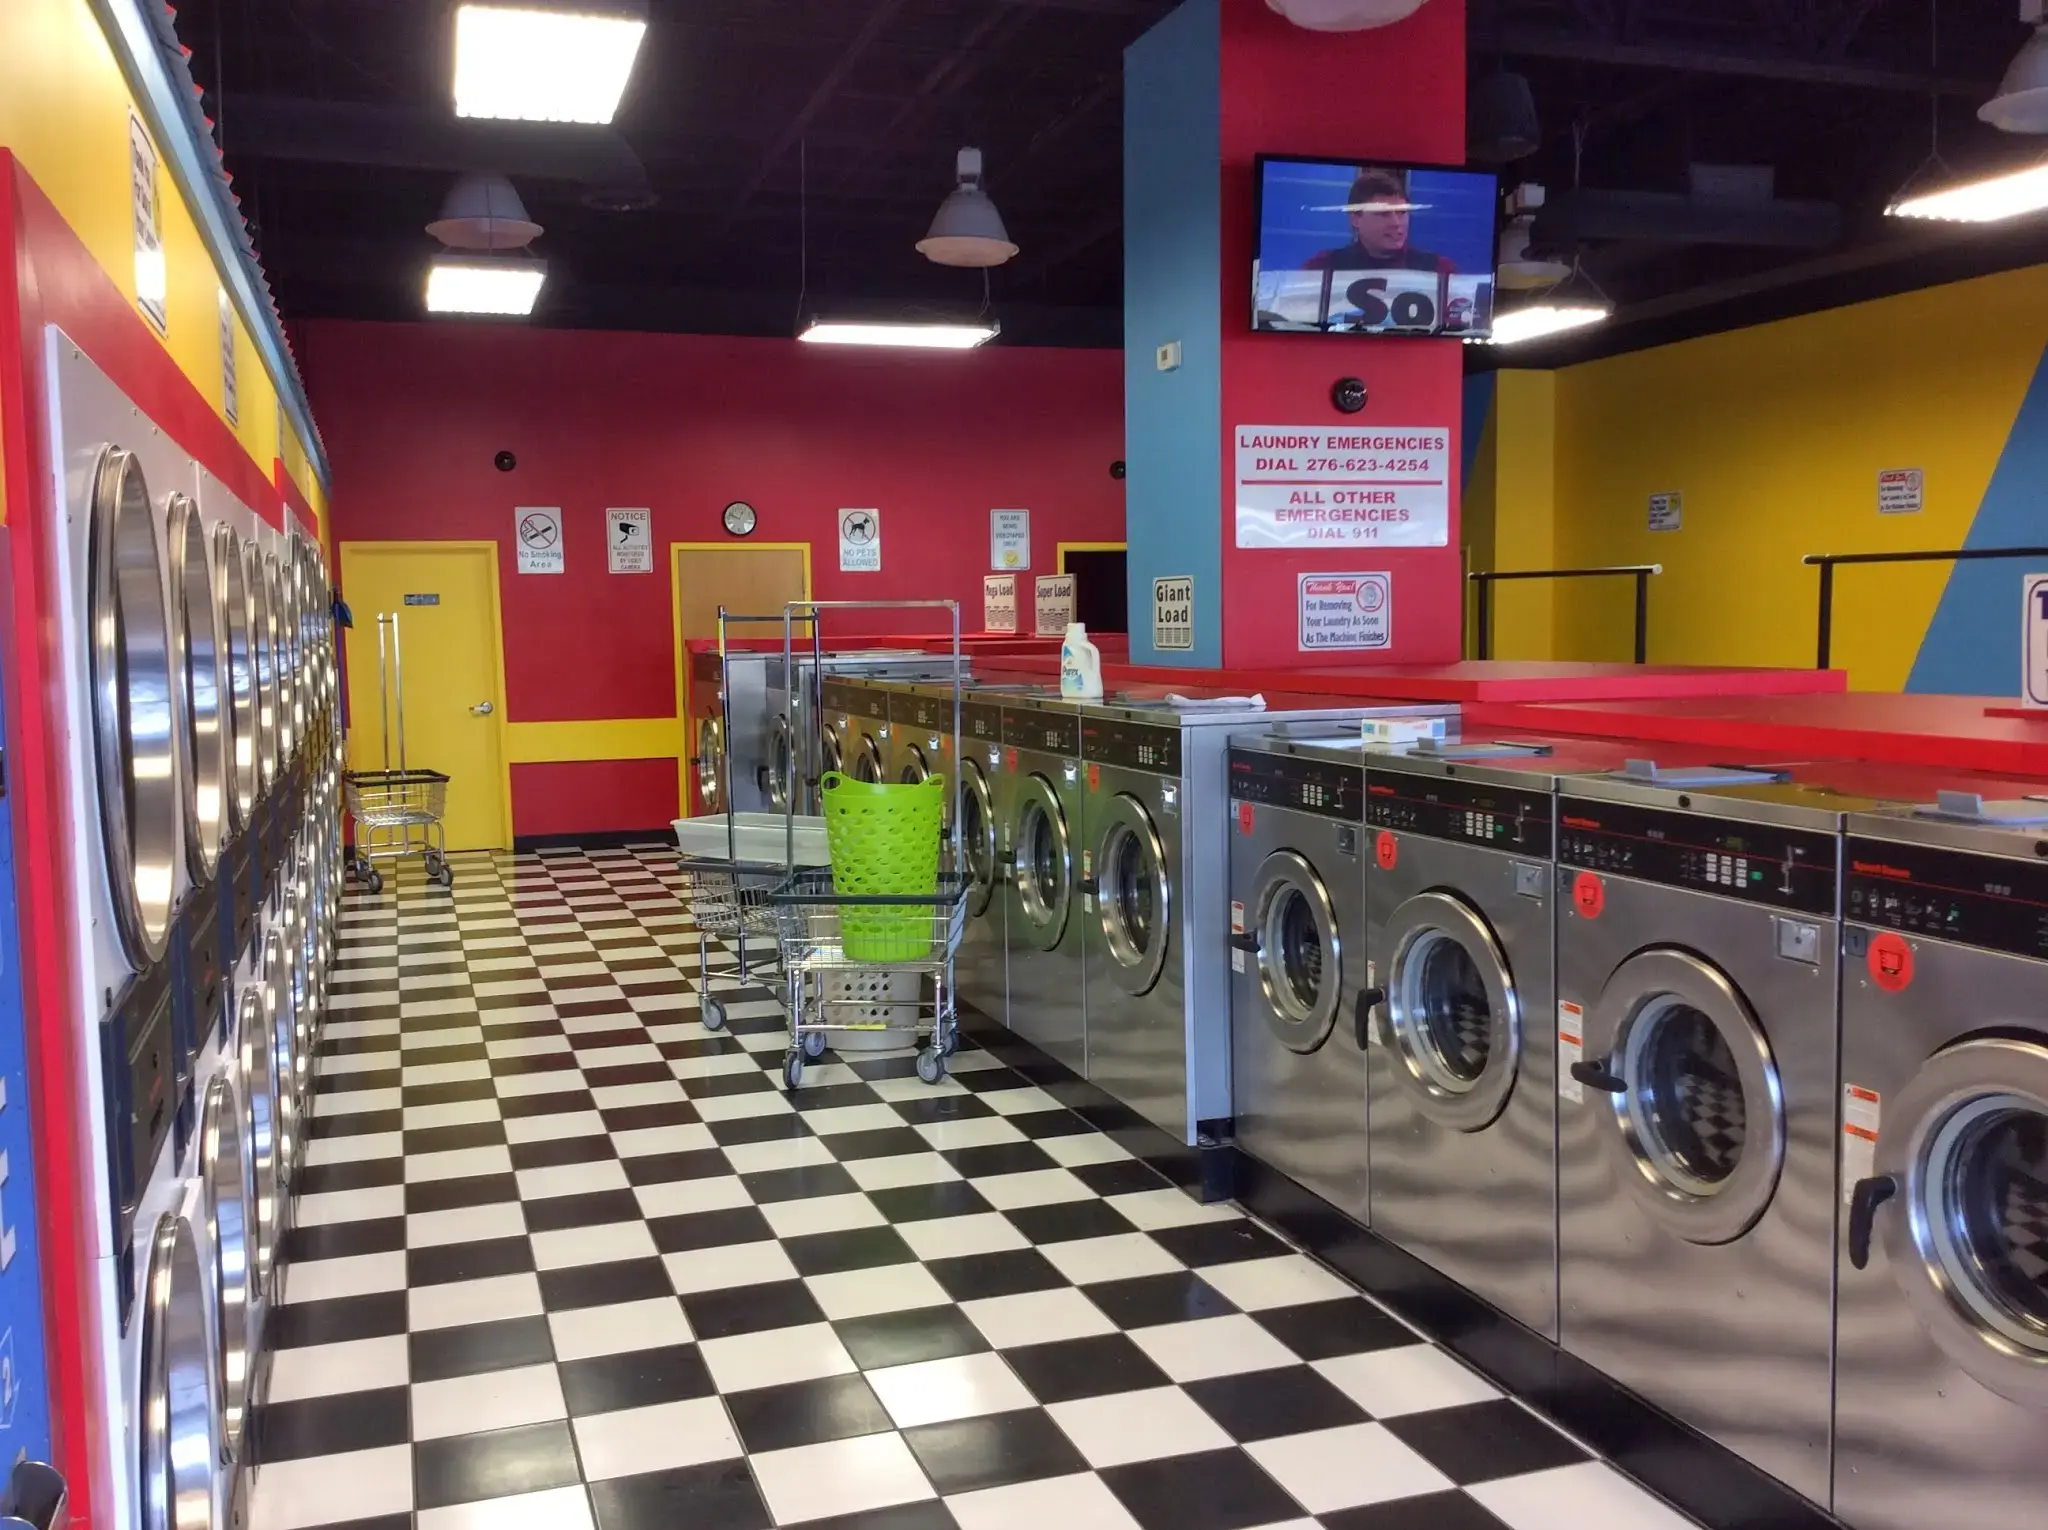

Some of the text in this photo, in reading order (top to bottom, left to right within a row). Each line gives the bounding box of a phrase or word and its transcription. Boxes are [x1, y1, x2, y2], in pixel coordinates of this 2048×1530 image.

[1346, 277, 1435, 326] So
[1240, 436, 1444, 450] LAUNDRY EMERGENCIES
[1256, 458, 1429, 472] DIAL 276-623-4254
[1289, 491, 1396, 504] ALL OTHER
[611, 512, 646, 520] NOTICE
[1275, 509, 1410, 522] EMERGENCIES
[1307, 528, 1378, 539] DIAL 911
[531, 551, 561, 560] Smoking
[843, 549, 877, 557] NO PETS
[843, 558, 878, 567] ALLOWED
[999, 583, 1013, 596] Load
[1037, 583, 1071, 600] Super Load
[1156, 584, 1190, 602] Giant
[1306, 600, 1352, 612] For Removing
[1158, 605, 1188, 623] Load
[1306, 615, 1378, 628] Your Laundry As Soon
[1306, 630, 1384, 643] As The Machine Finishes
[1063, 665, 1079, 676] Purex
